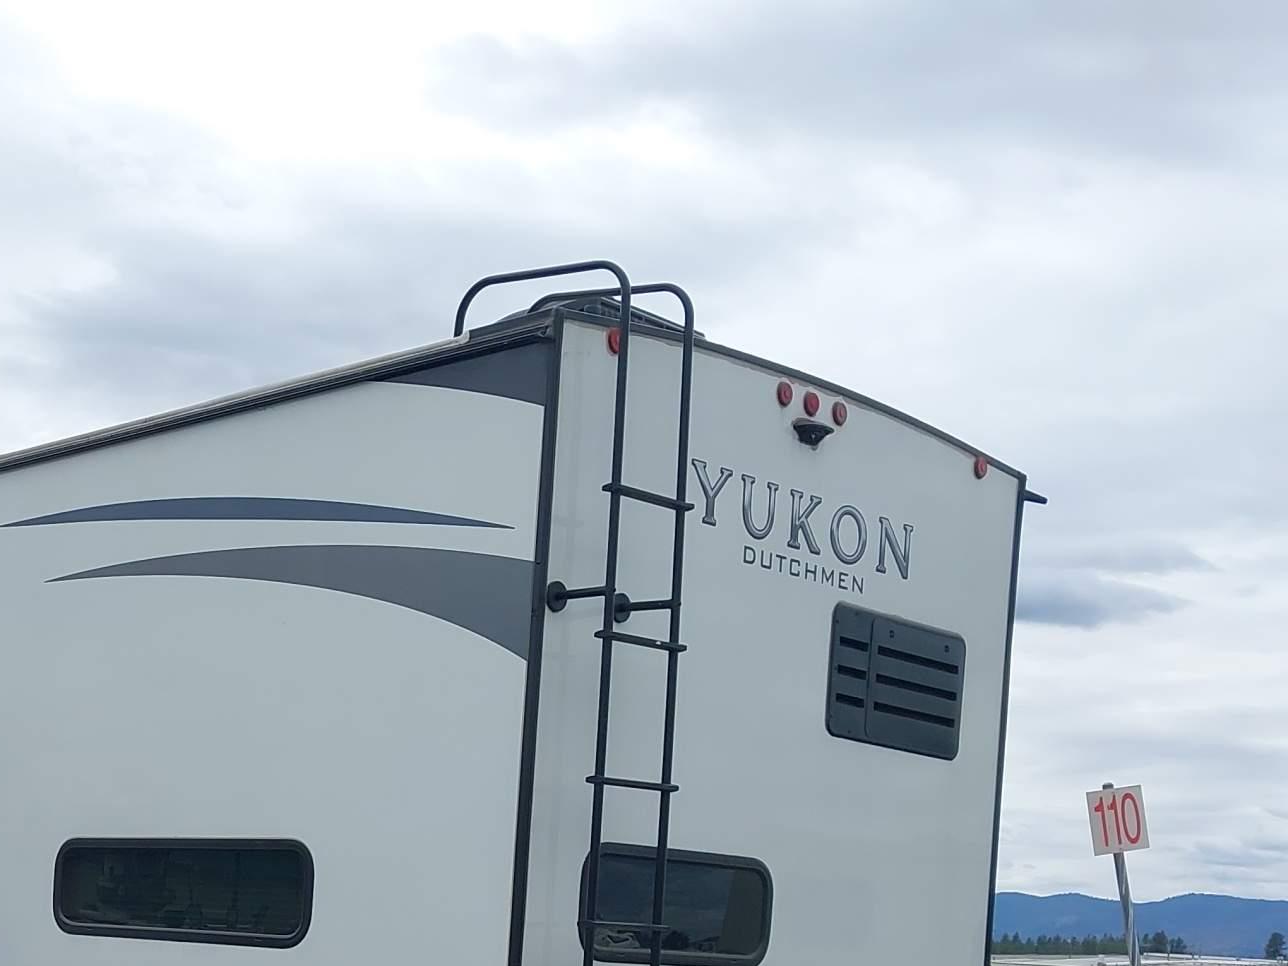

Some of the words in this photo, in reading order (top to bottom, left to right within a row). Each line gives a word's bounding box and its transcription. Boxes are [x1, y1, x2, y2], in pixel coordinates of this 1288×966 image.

[691, 458, 914, 579] YUKON
[743, 545, 864, 594] DUTCHMEN
[1094, 792, 1141, 847] 110
